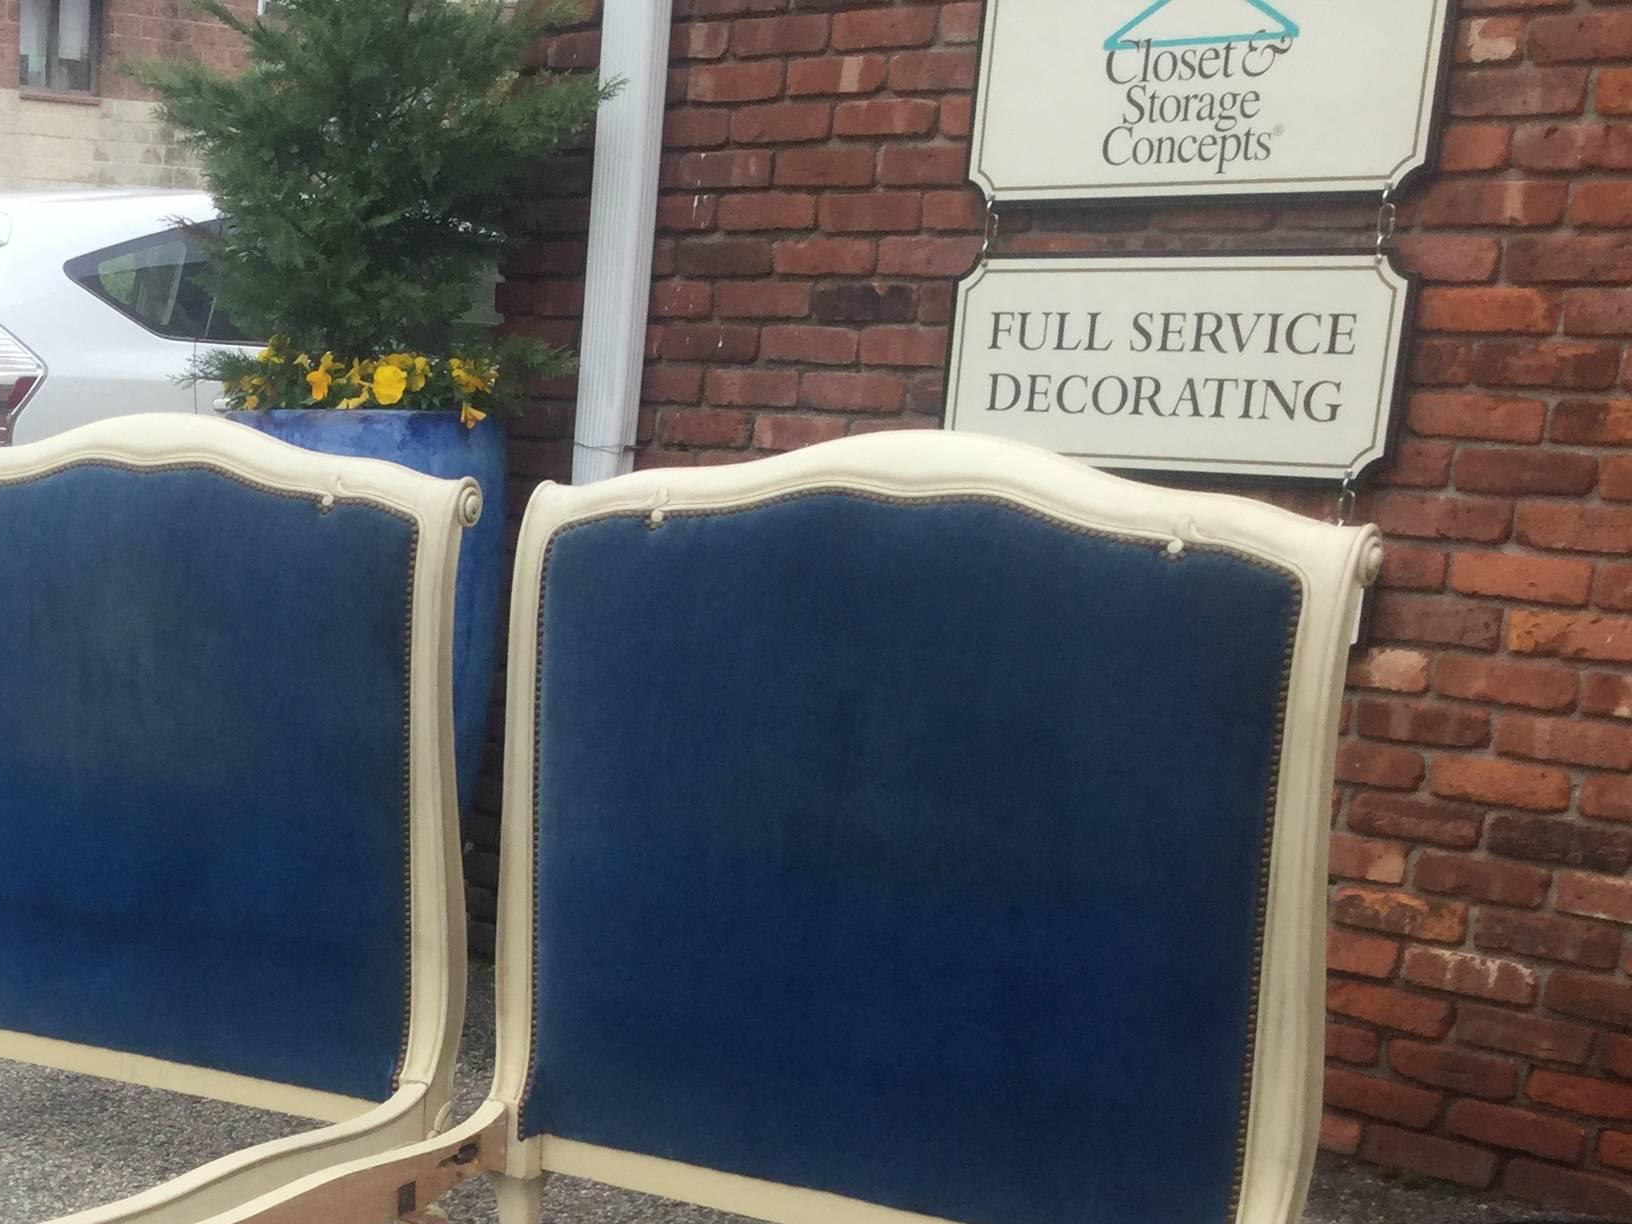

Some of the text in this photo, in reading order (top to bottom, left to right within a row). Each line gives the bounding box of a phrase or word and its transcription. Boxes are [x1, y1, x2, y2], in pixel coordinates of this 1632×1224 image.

[1106, 29, 1293, 84] Closet &
[1122, 85, 1261, 132] Storage
[986, 311, 1359, 356] FULL SERVICE
[985, 372, 1344, 423] DECORATING
